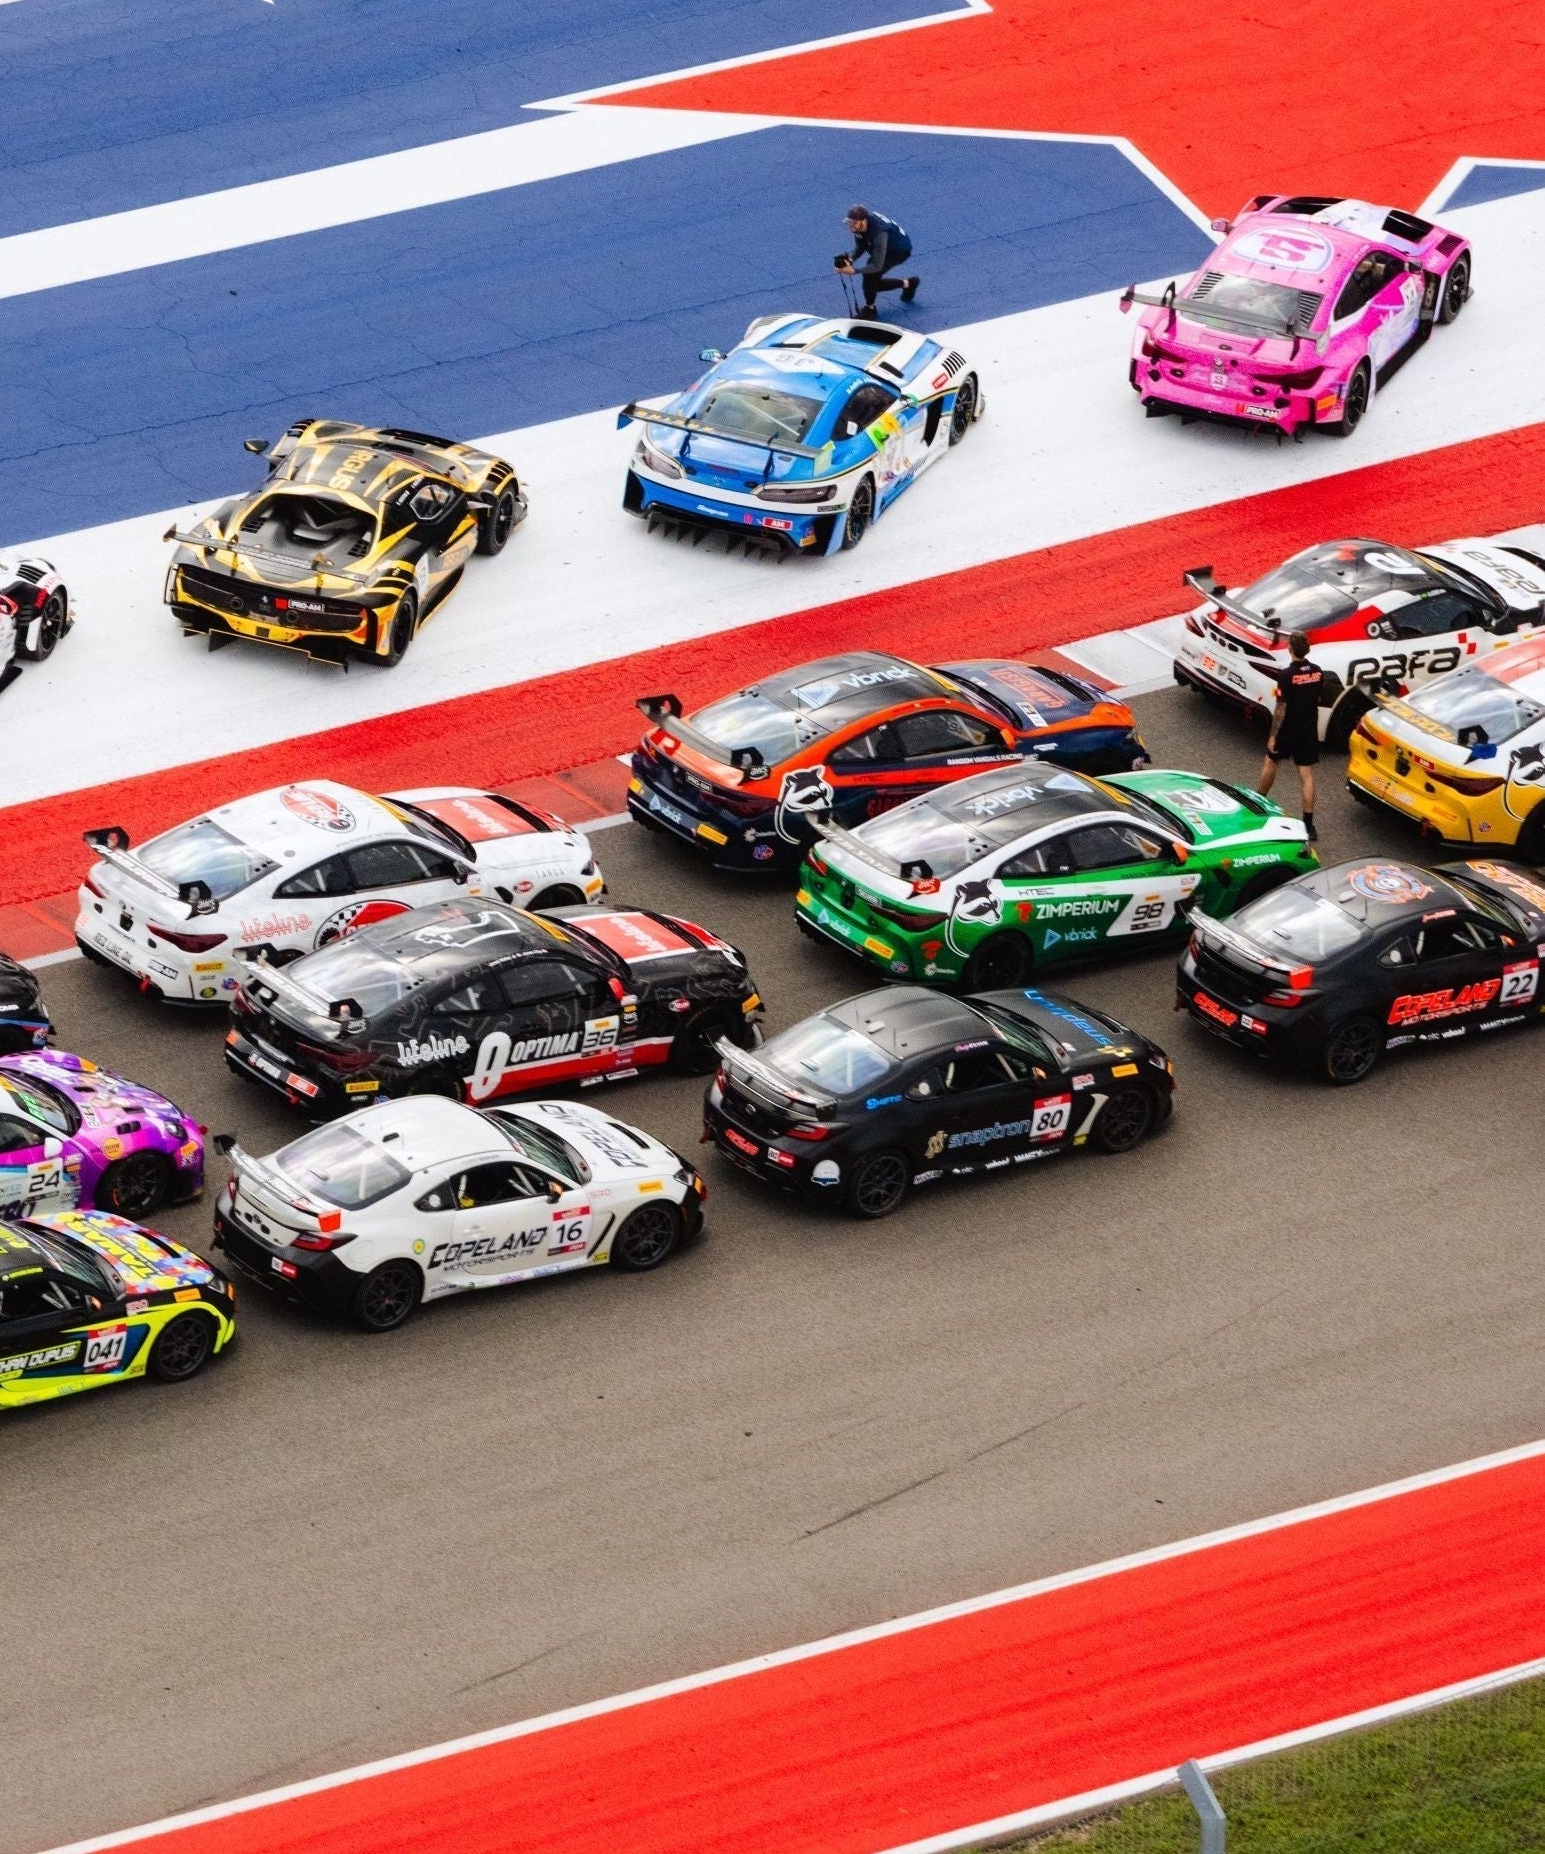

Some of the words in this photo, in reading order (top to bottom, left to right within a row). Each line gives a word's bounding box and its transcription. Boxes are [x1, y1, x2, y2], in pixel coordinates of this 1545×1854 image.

[1246, 406, 1278, 418] PRO-AM
[290, 601, 322, 612] PRO-AM
[843, 664, 921, 689] vbrick
[946, 756, 973, 766] RANDOM
[973, 754, 1002, 763] VANDALS
[1001, 752, 1023, 761] RACING
[966, 783, 1045, 816] vbrick
[1232, 852, 1281, 868] ZIMPERIUM
[1018, 887, 1055, 896] HTEC
[1036, 899, 1119, 920] ZIMPERIUM
[1132, 901, 1165, 922] 98
[1063, 926, 1098, 942] vbrick
[1506, 974, 1534, 997] 22
[1387, 978, 1502, 1025] COPELAND
[511, 1031, 580, 1063] OPTIMA
[585, 1029, 618, 1049] 36
[1036, 1109, 1063, 1132] 80
[948, 1119, 1032, 1148] snaptron
[28, 1170, 61, 1194] 24
[557, 1220, 583, 1245] 16
[427, 1226, 548, 1270] COPELAND
[28, 1345, 77, 1368] DUPUIS
[89, 1337, 124, 1363] 041
